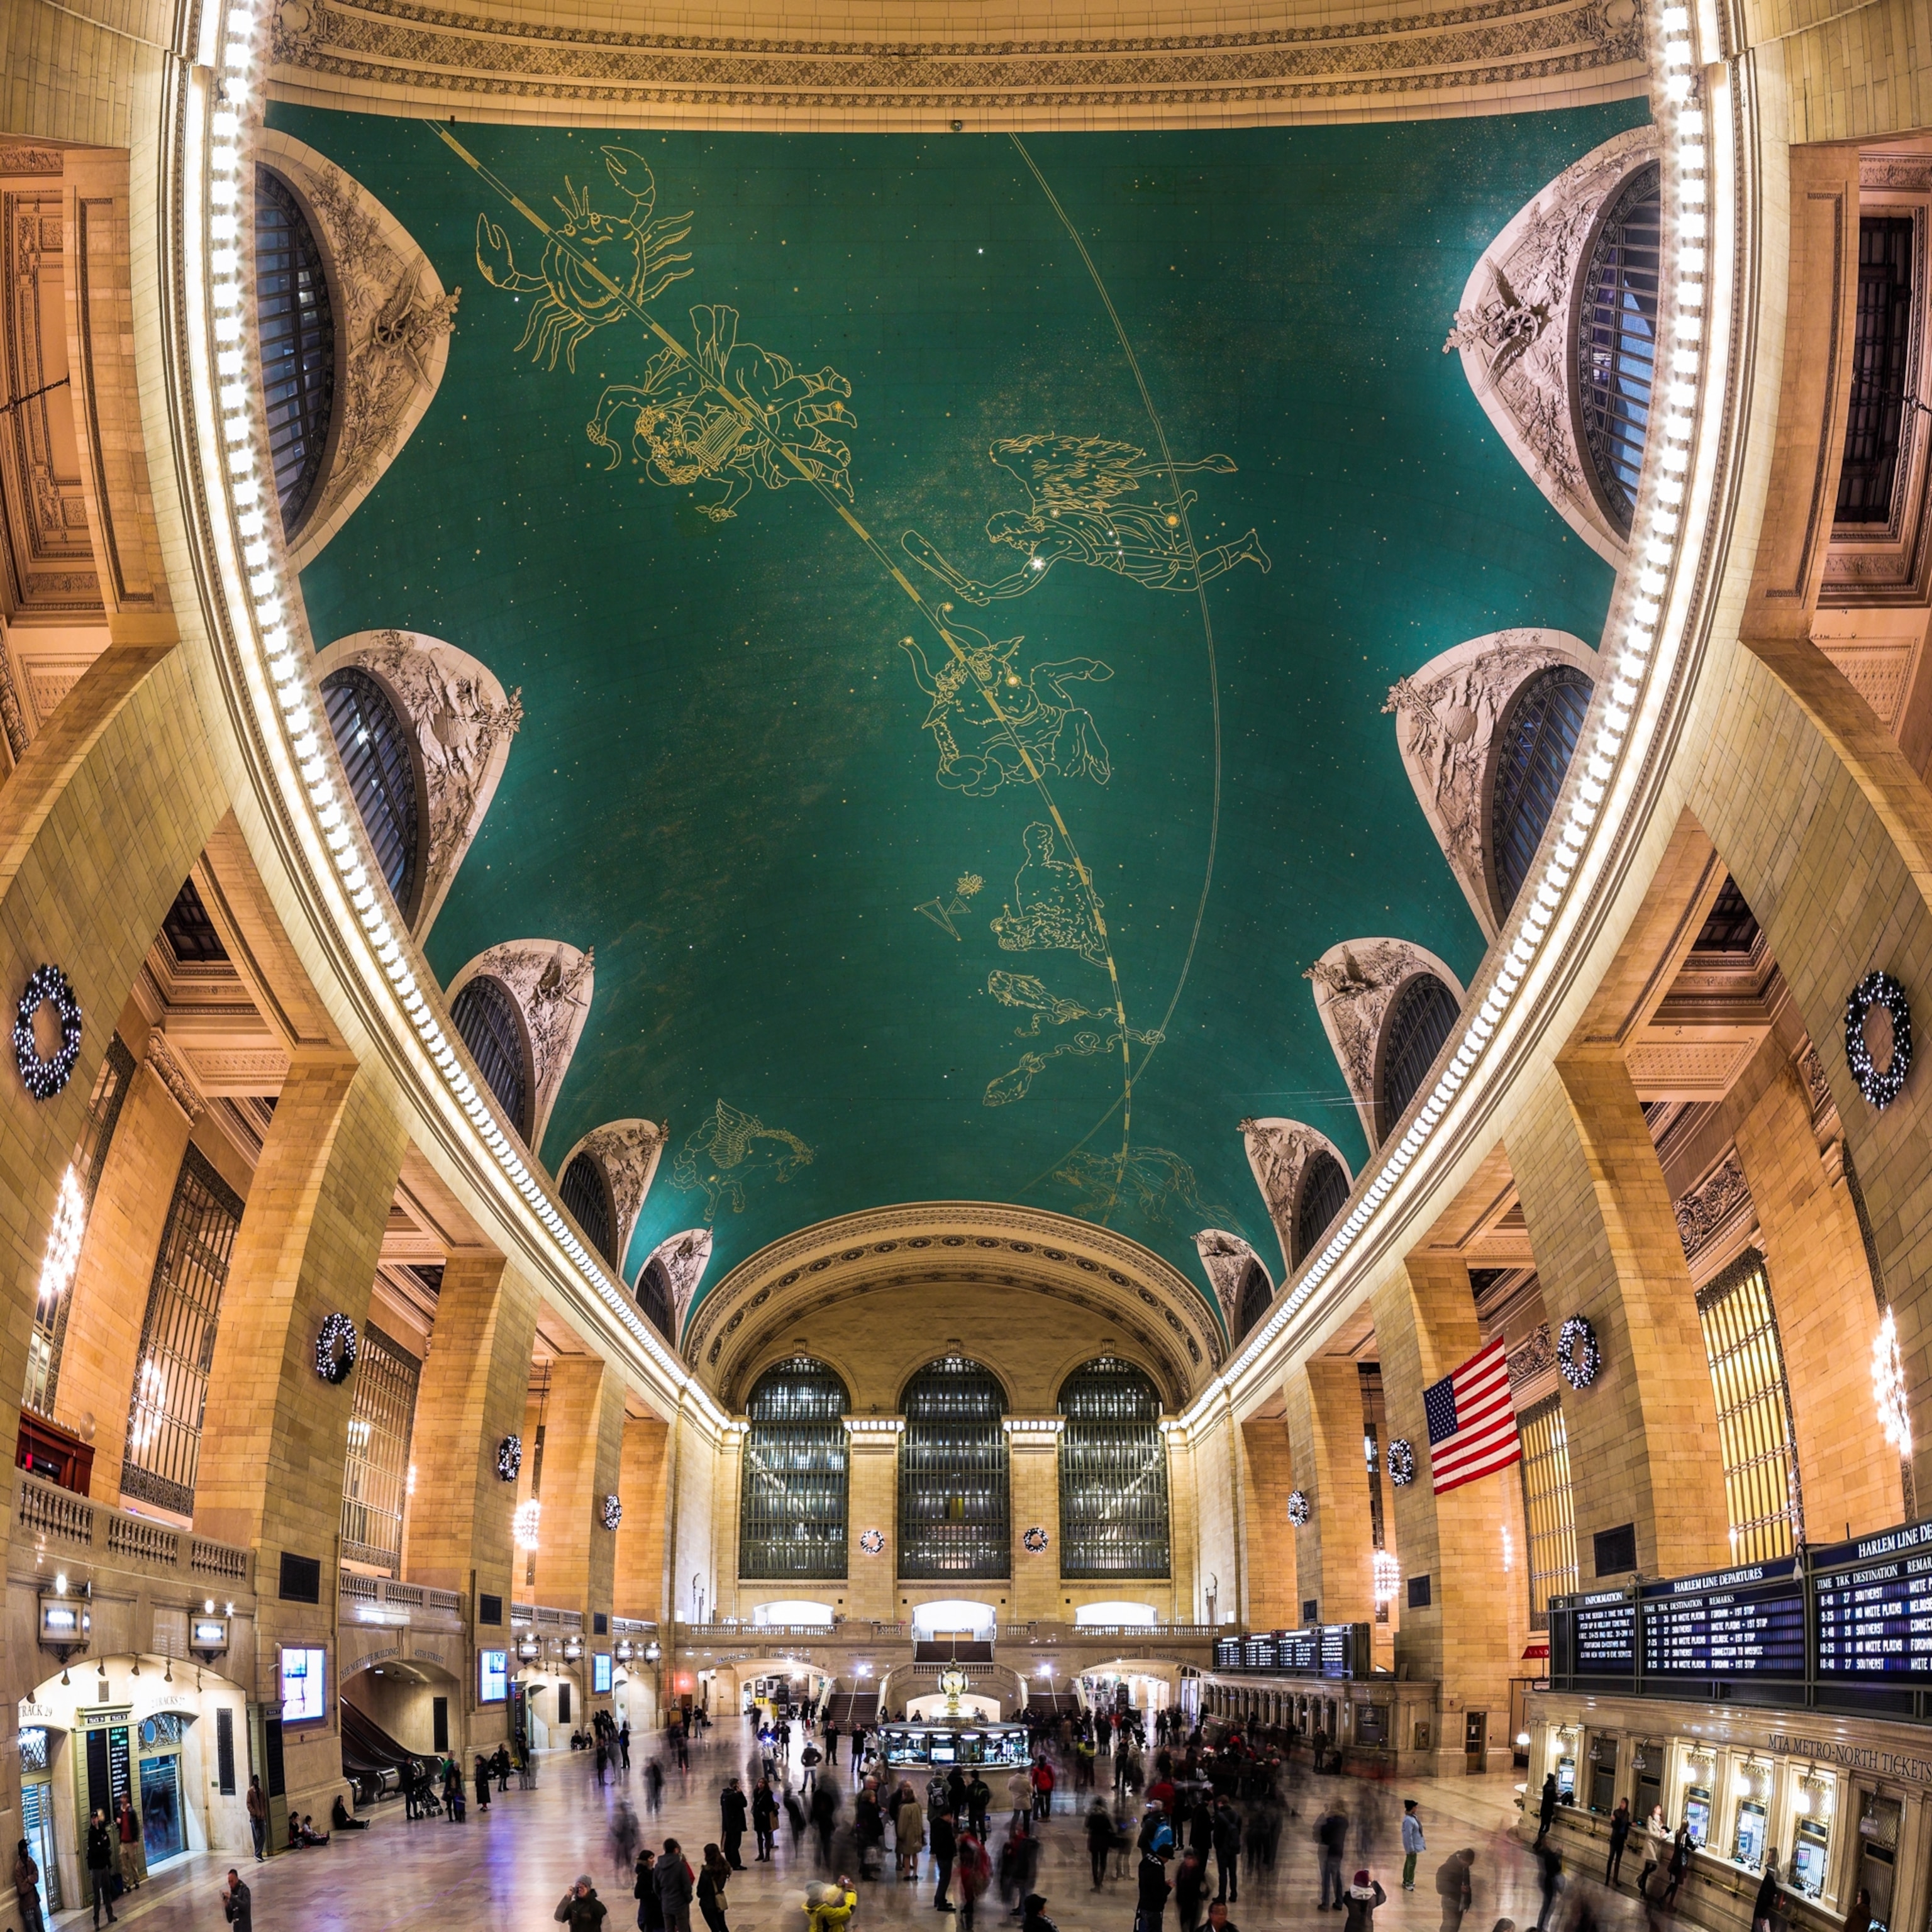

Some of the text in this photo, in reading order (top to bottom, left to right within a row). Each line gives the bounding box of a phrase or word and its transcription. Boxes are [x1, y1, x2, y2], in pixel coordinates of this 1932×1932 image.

[1858, 1535, 1895, 1558] HARLEM
[1897, 1528, 1918, 1548] LINE
[1674, 1567, 1763, 1592] HARLEM LINE DEPARTURES
[1816, 1577, 1833, 1590] TIME
[1836, 1575, 1850, 1587] TRK
[1853, 1563, 1898, 1584] DESTINATION
[1843, 1592, 1850, 1603] 27
[1855, 1587, 1883, 1602] SOUTHEAST
[1909, 1579, 1926, 1593] WHITE
[1585, 1592, 1623, 1605] INFORMATION
[1644, 1594, 1735, 1613] TIME TRK DESTINATION REMARKS
[1690, 1611, 1705, 1621] PLAINS
[1743, 1605, 1755, 1616] STOP
[1821, 1610, 1834, 1622] 9:25
[1844, 1608, 1851, 1620] 17
[1855, 1607, 1863, 1619] NO
[1865, 1604, 1880, 1617] WHITE
[1882, 1602, 1902, 1616] PLAINS
[1672, 1625, 1692, 1634] SOUTHEAST
[1756, 1618, 1767, 1628] STOP
[1856, 1623, 1884, 1635] SOUTHEAST
[1691, 1635, 1706, 1645] PLAINS
[1744, 1633, 1755, 1642] STOP
[374, 1648, 399, 1660] BUILDING
[1672, 1648, 1693, 1657] SOUTHEAST
[1820, 1642, 1835, 1654] 10:25
[1845, 1641, 1852, 1653] 16
[1856, 1641, 1863, 1653] NO
[1865, 1640, 1881, 1652] WHITE
[1883, 1640, 1902, 1652] PLAINS
[427, 1652, 444, 1664] STREET
[1692, 1660, 1706, 1668] PLAINS
[1745, 1660, 1756, 1668] STOP
[1820, 1658, 1835, 1669] 10:48
[1845, 1658, 1852, 1670] 27
[1857, 1658, 1884, 1670] SOUTHEAST
[1911, 1658, 1928, 1670] WHITE
[18, 1704, 52, 1718] TRACK 29
[1768, 1733, 1932, 1782] MTA METRO-NORTH TICKETS
